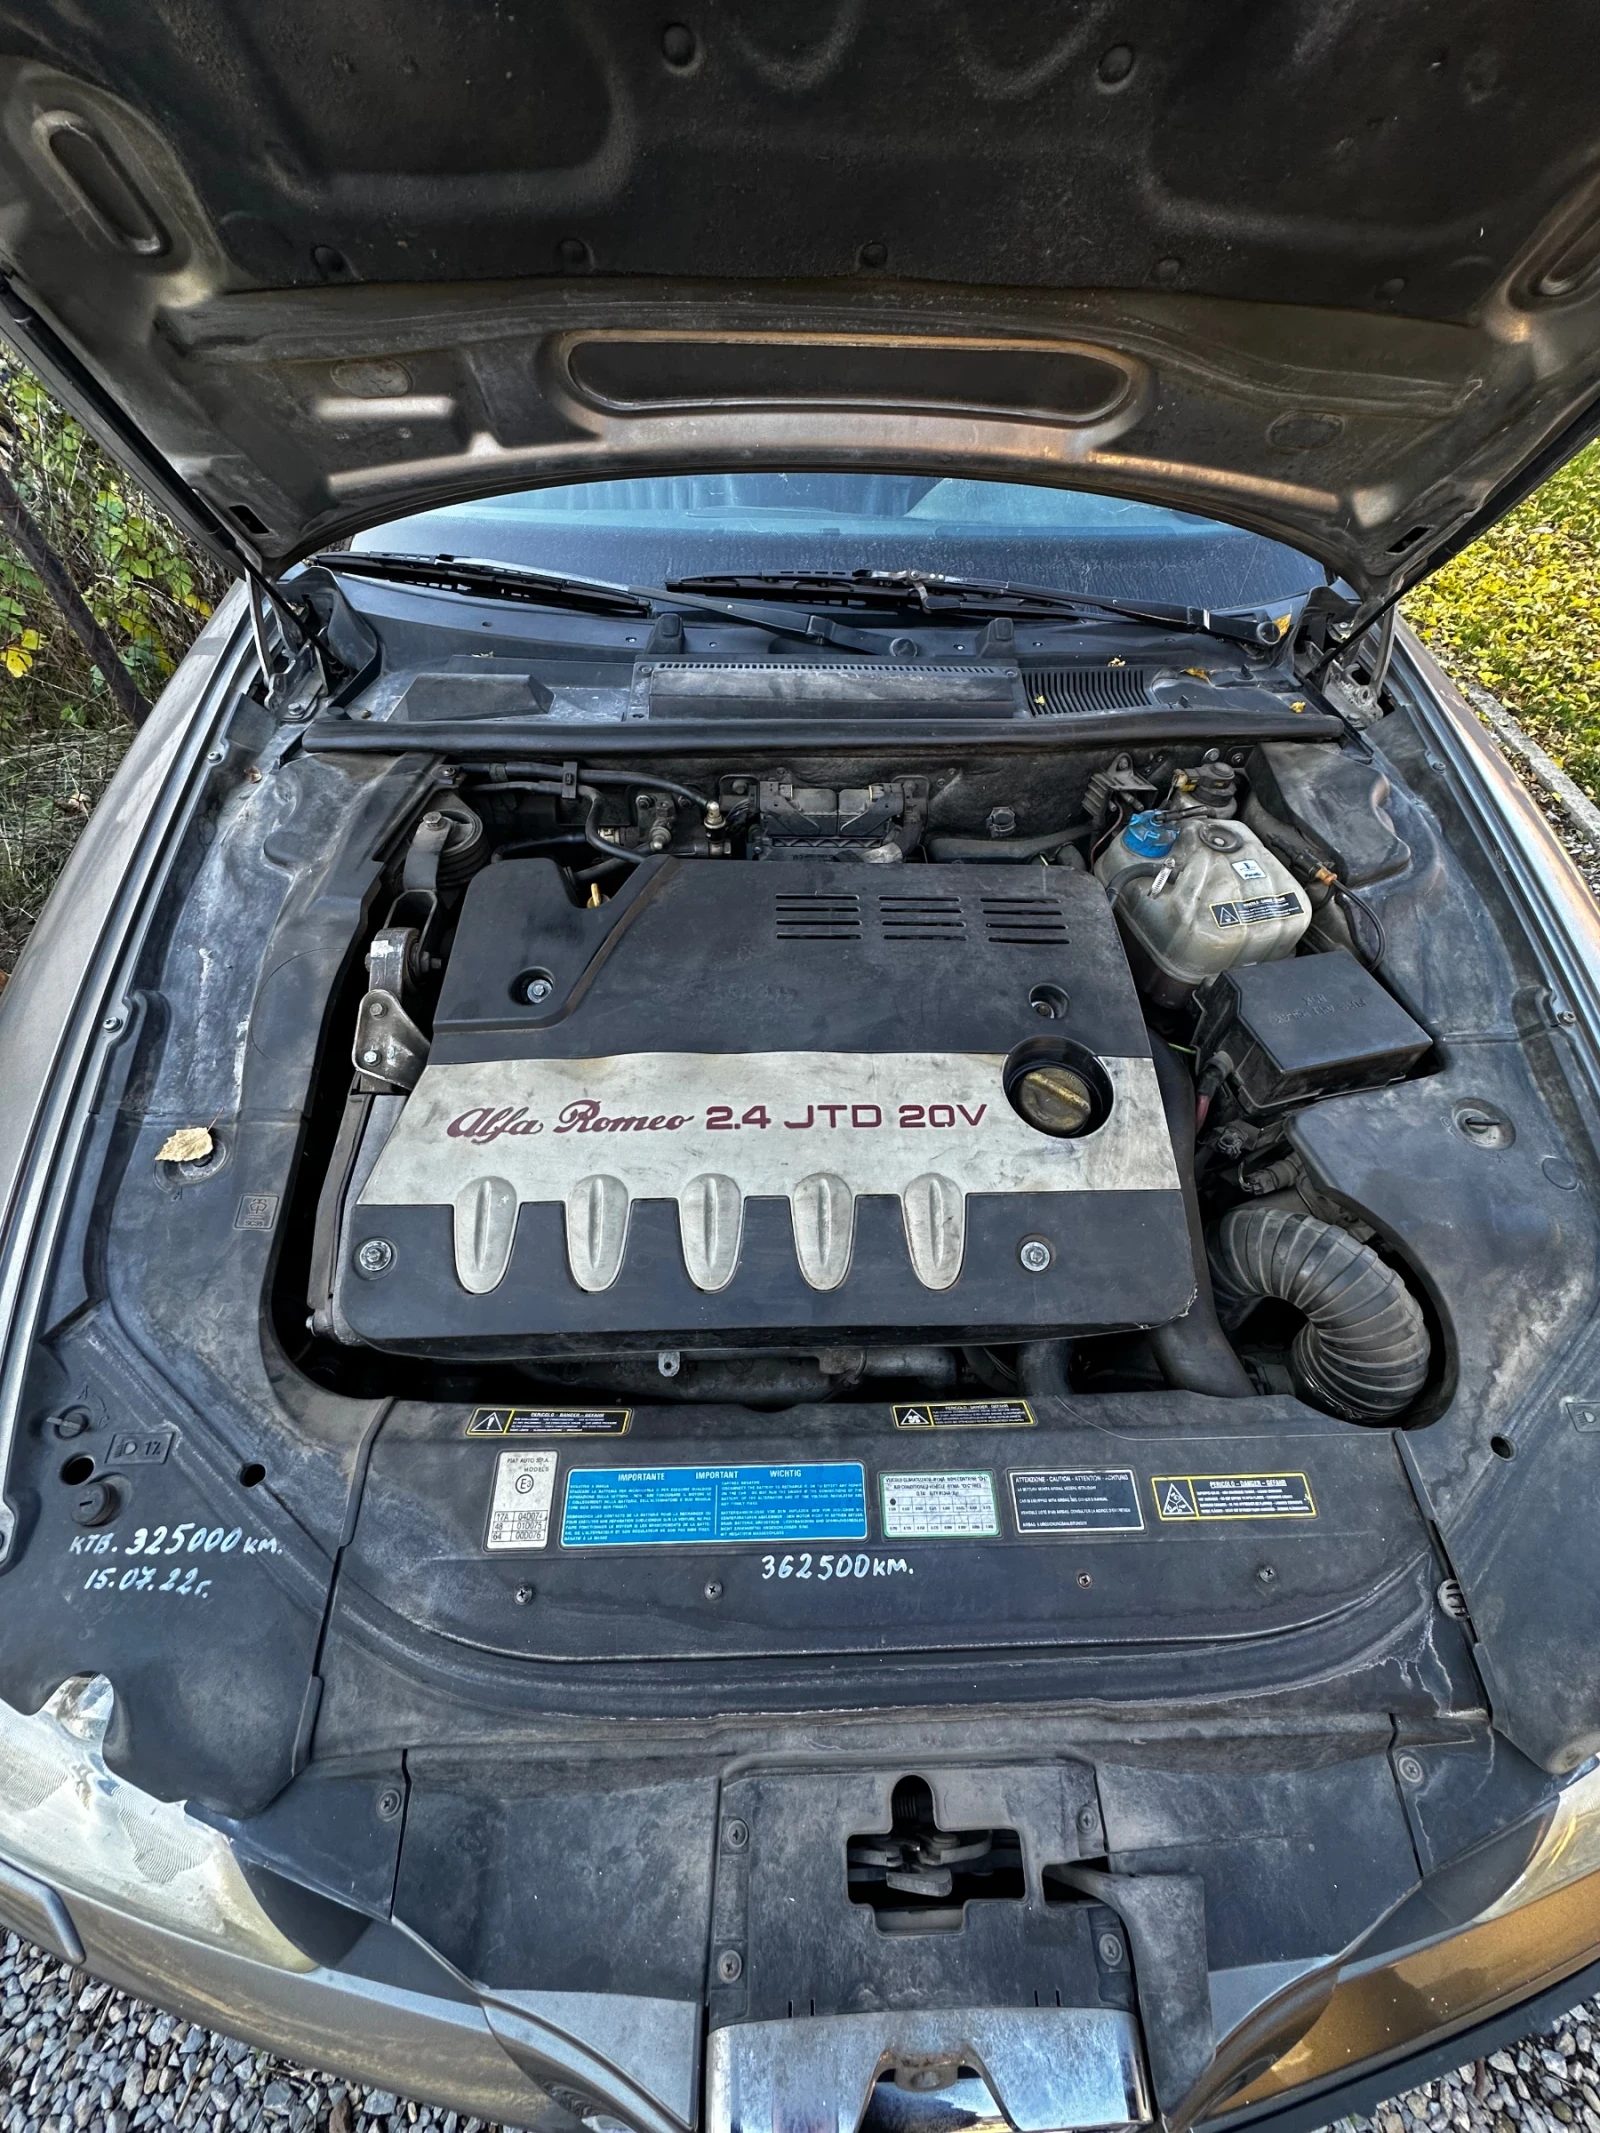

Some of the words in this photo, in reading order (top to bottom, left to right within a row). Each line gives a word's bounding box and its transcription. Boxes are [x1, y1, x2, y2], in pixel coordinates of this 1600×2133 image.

[447, 1107, 544, 1145] Alfa
[553, 1099, 695, 1135] Romeo
[706, 1105, 772, 1129] 2.4
[784, 1105, 882, 1129] JTD
[900, 1104, 988, 1128] 20V
[618, 1473, 665, 1481] IMPORTANTE
[695, 1471, 738, 1480] IMPORTANT
[770, 1470, 802, 1478] WICHTIG
